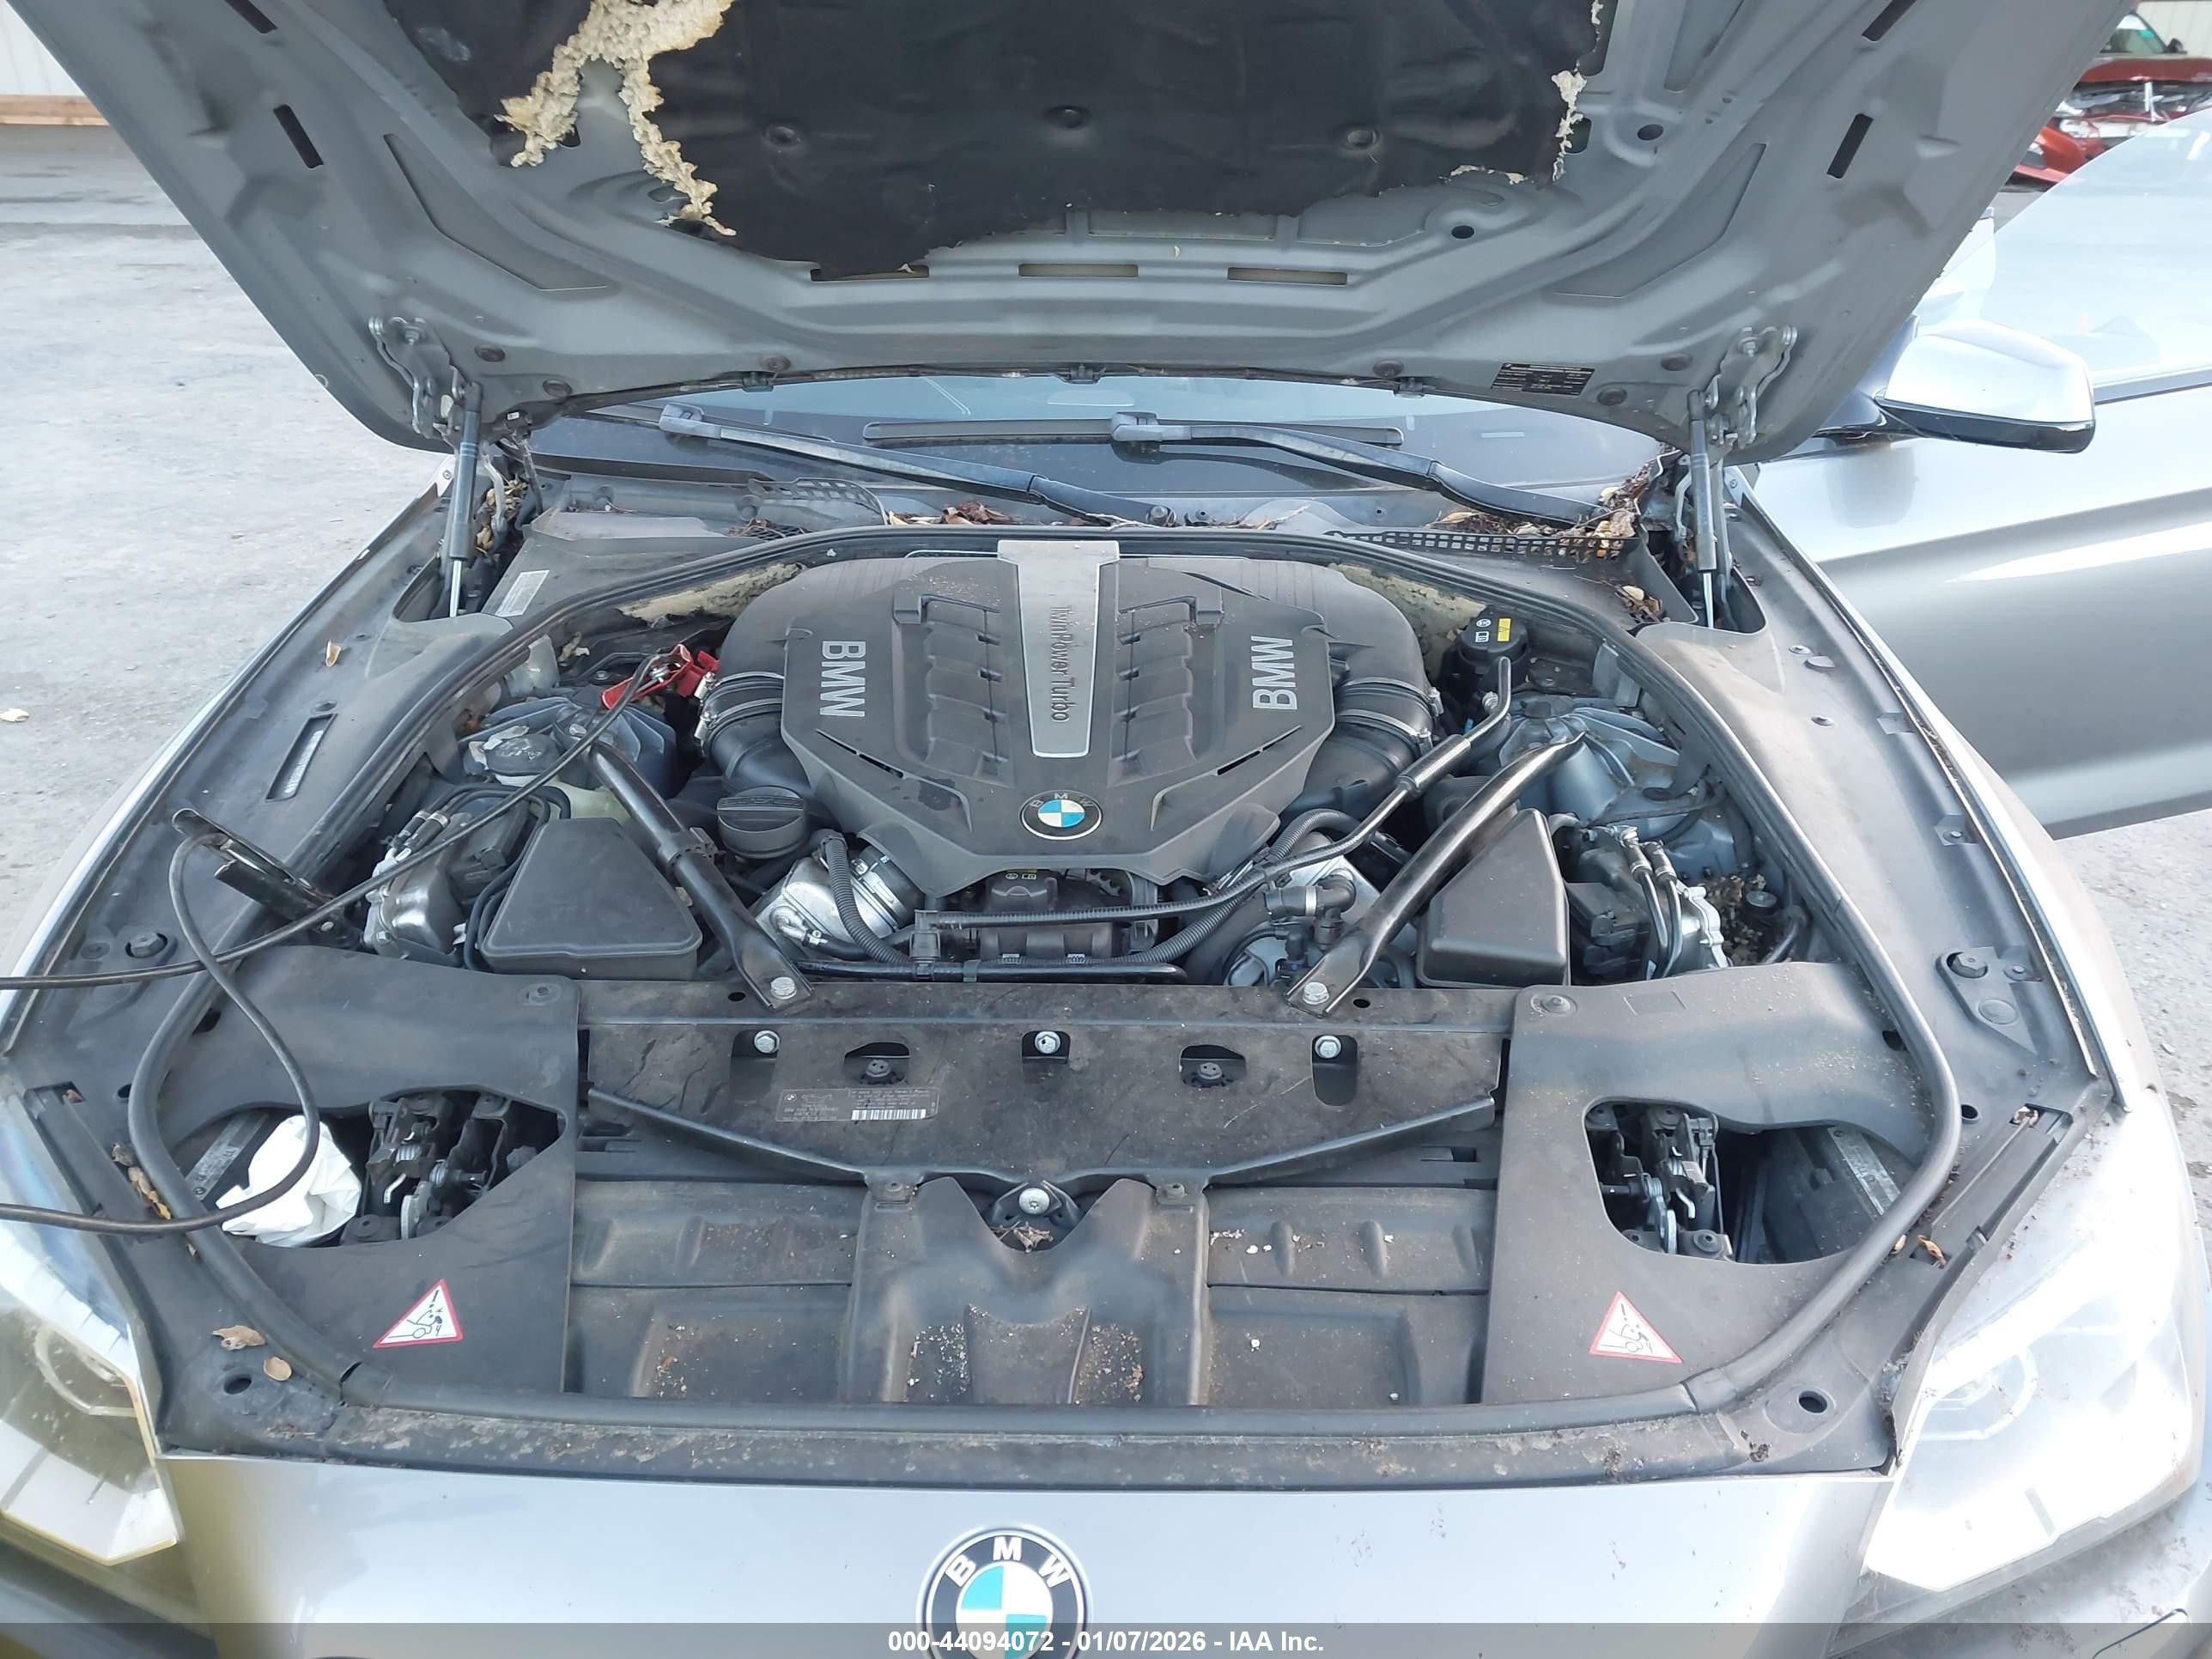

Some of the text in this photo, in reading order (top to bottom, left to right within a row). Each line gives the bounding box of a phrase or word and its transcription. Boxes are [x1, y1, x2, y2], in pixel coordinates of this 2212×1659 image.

[819, 641, 866, 717] BMW
[1250, 635, 1298, 710] BMW
[1050, 678, 1079, 722] Turbo
[1030, 793, 1095, 808] BMW
[945, 1535, 1071, 1588] BMW
